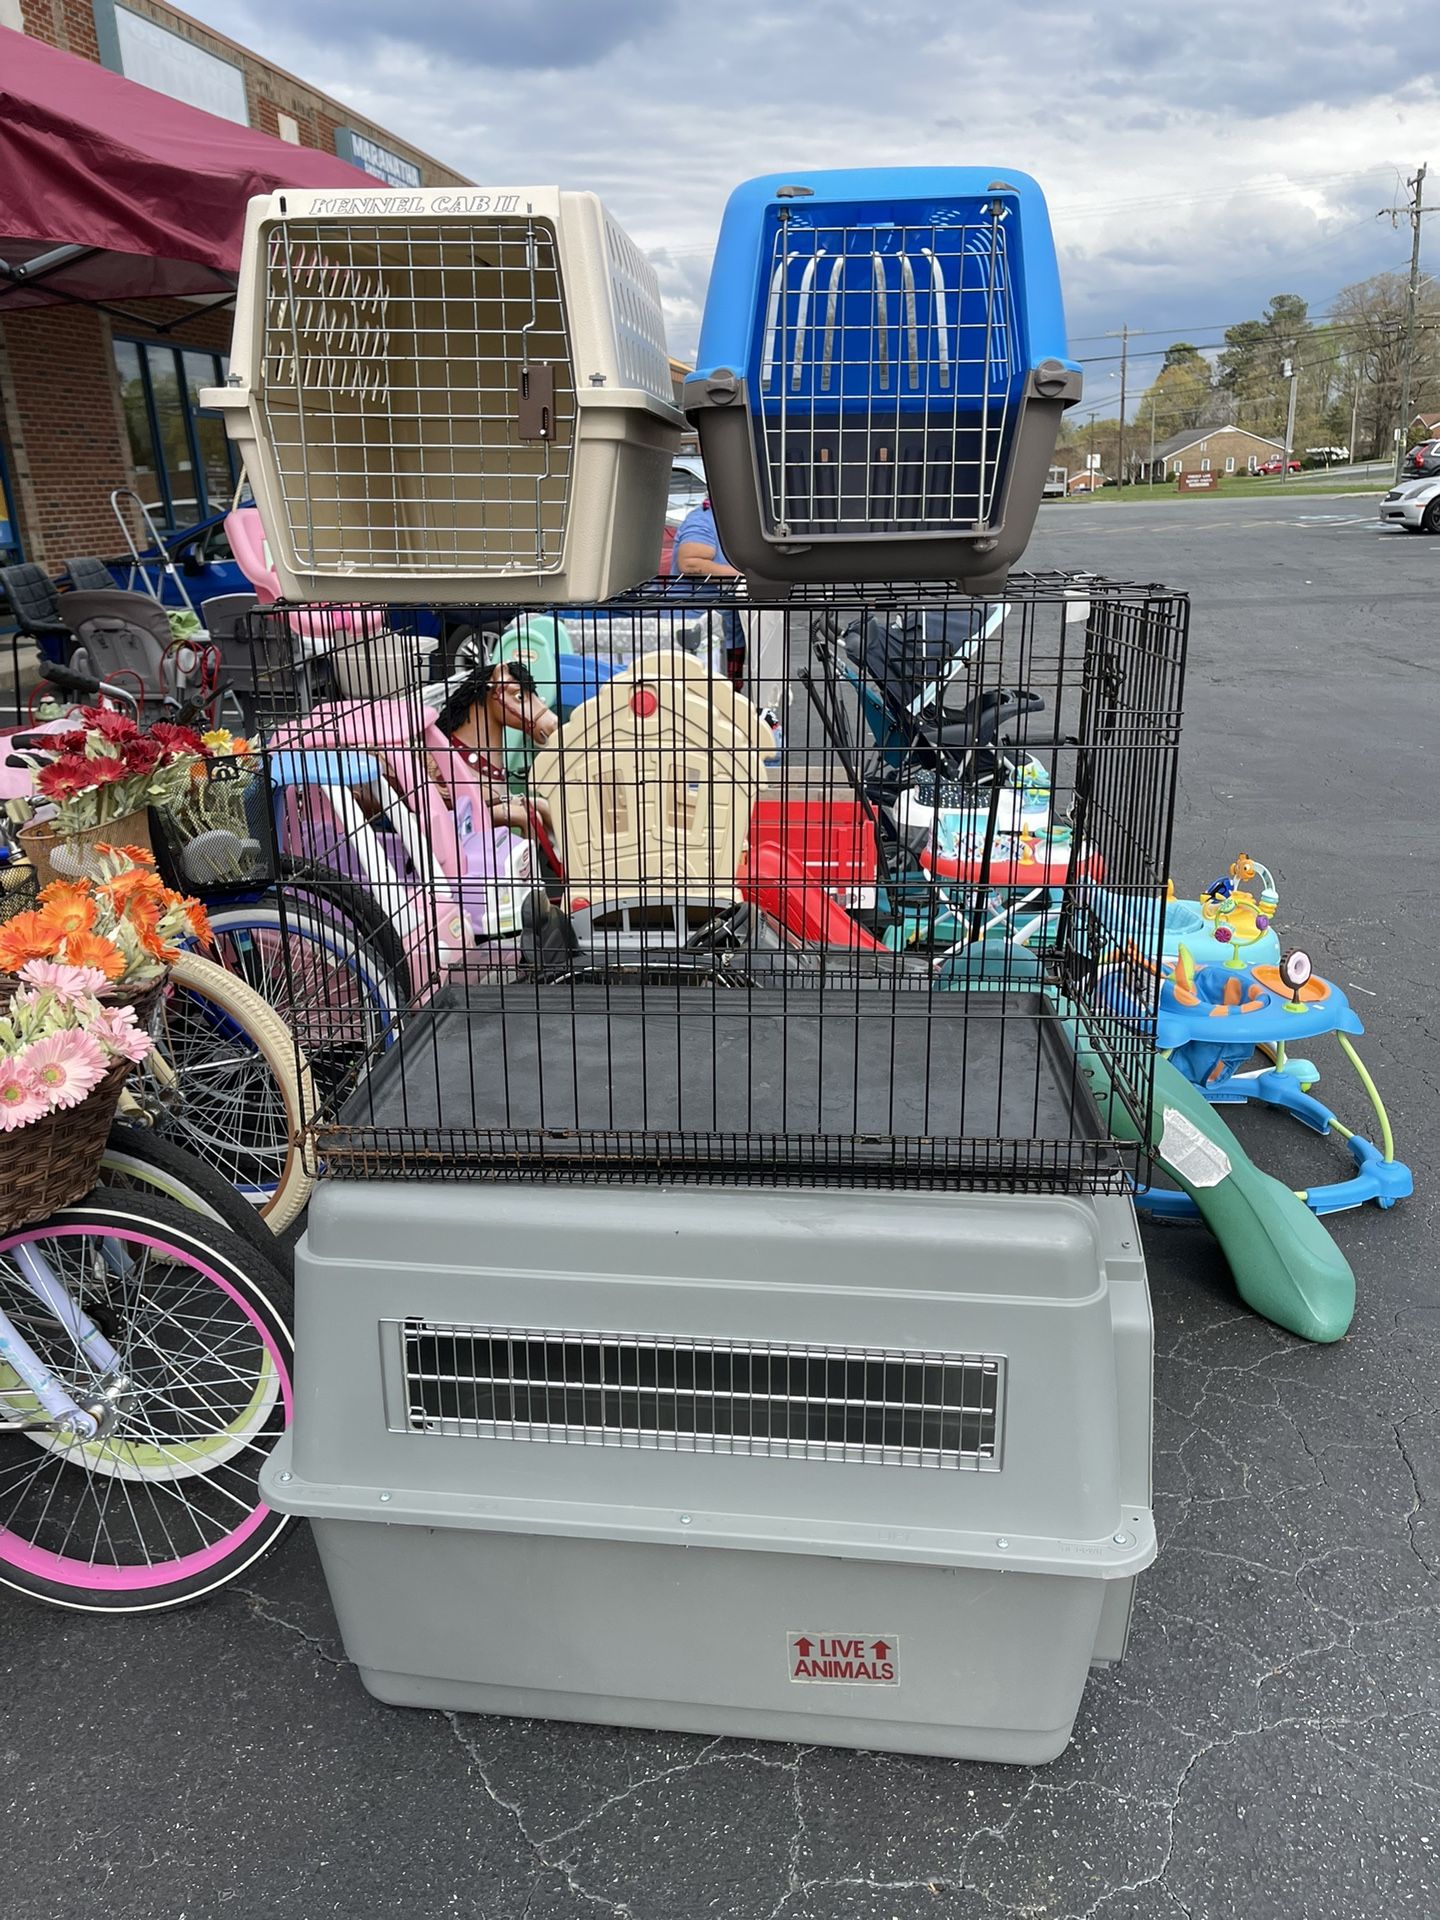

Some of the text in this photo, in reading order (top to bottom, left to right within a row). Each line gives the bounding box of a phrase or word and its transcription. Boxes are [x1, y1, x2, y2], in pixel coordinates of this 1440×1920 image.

[351, 133, 420, 188] MARANATHA
[309, 195, 520, 215] KENNEL CAB II
[819, 1639, 865, 1658] LIVE
[794, 1659, 894, 1680] ANIMALS
